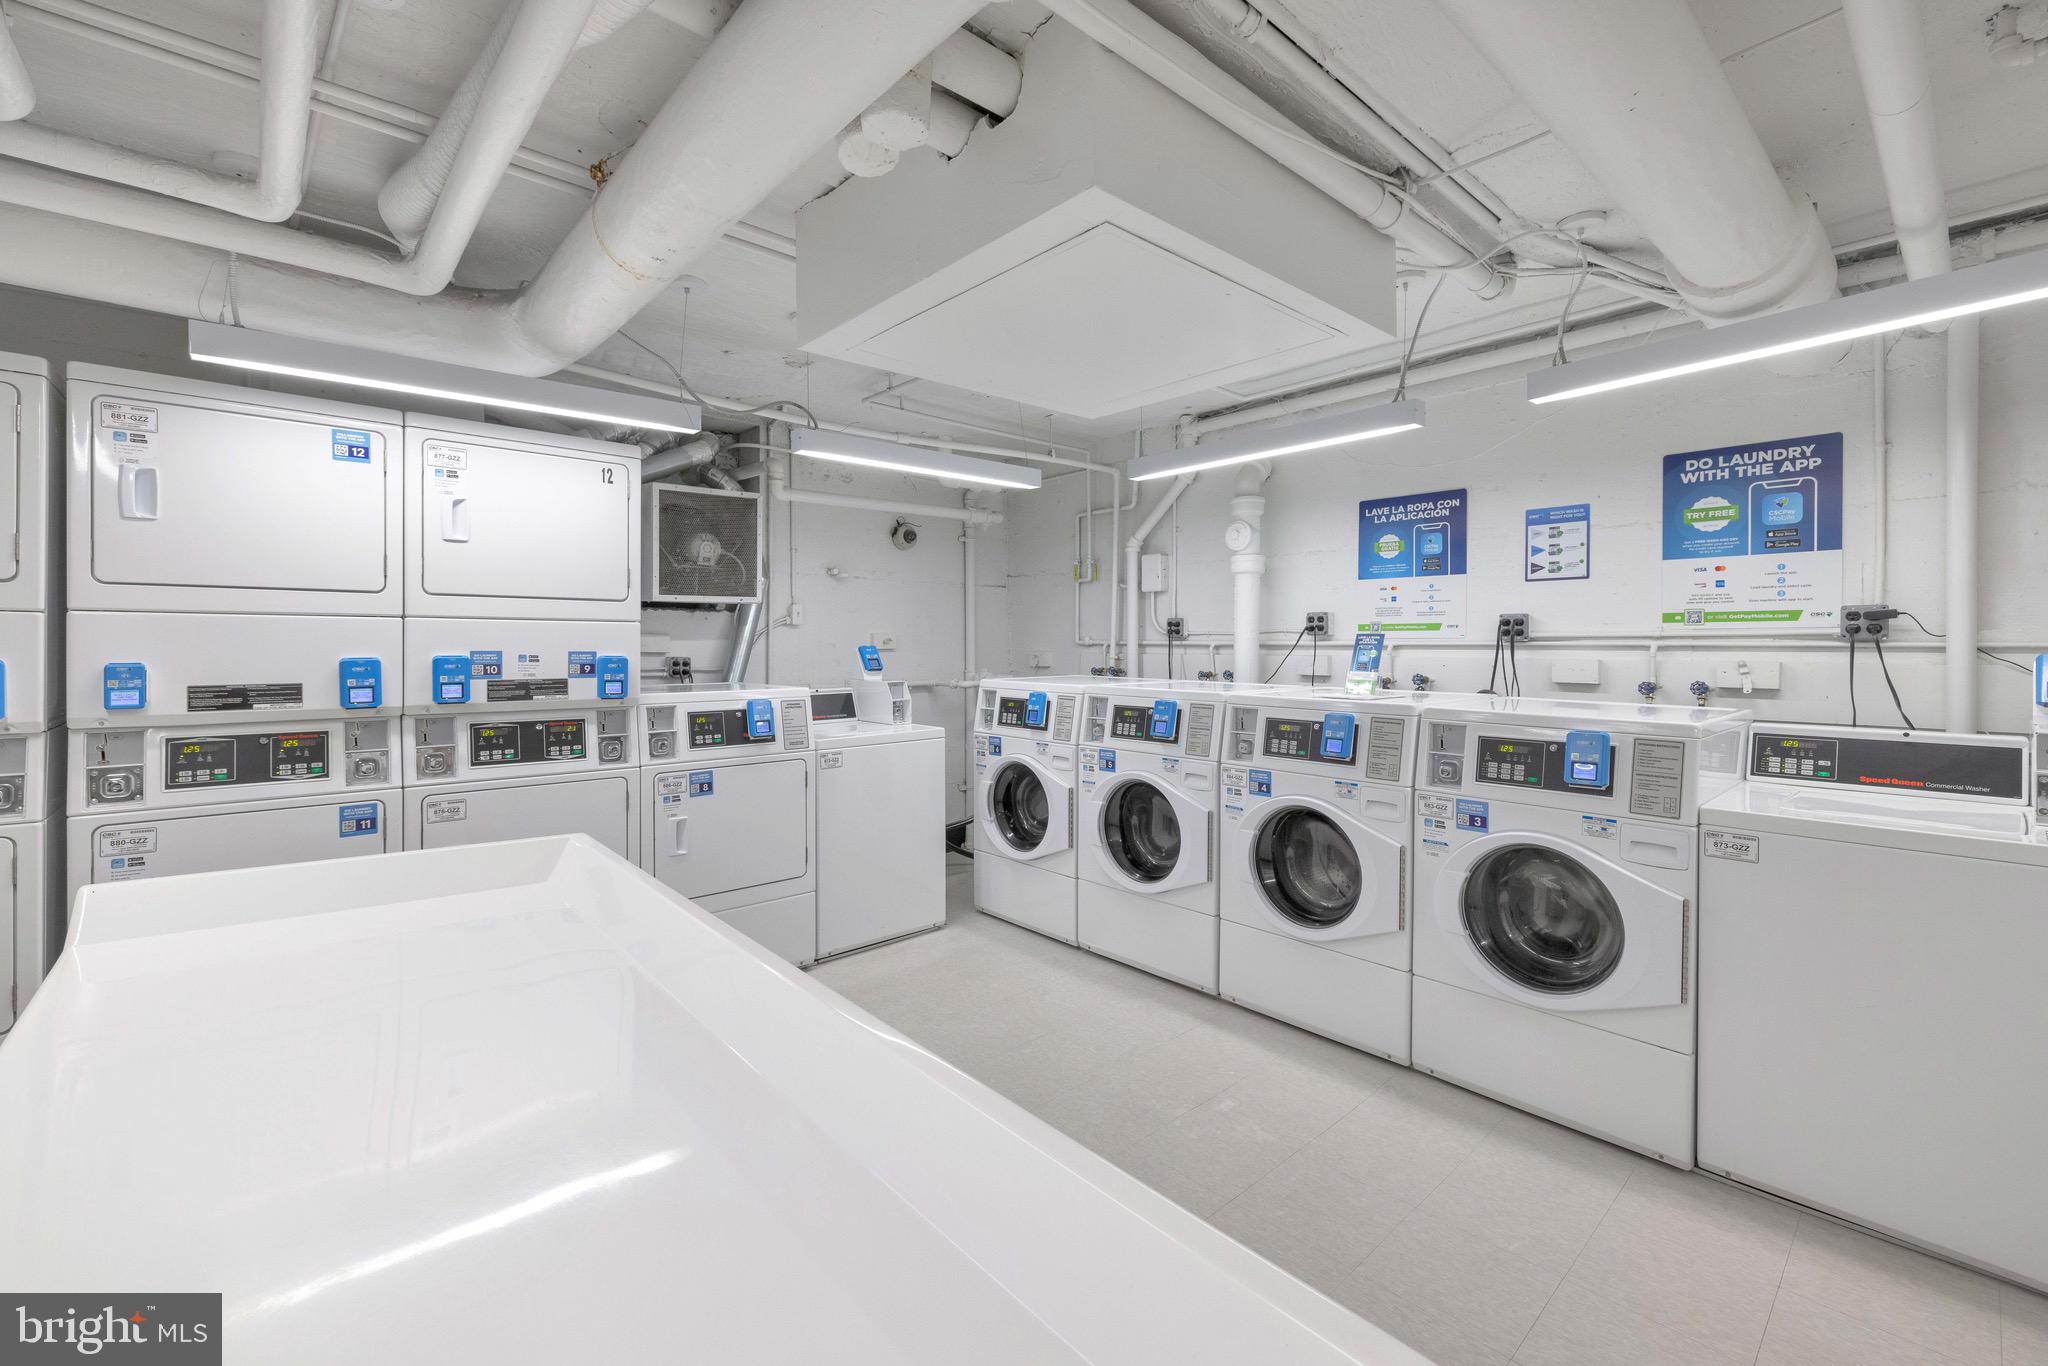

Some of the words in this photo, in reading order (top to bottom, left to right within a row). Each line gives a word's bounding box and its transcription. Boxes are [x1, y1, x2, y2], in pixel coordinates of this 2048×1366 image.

[110, 412, 149, 422] 881-GZZ
[352, 448, 366, 458] 12
[1686, 458, 1712, 471] DO
[1719, 444, 1816, 467] LAUNDRY
[602, 468, 614, 484] 12
[1680, 470, 1729, 484] WITH
[1735, 462, 1774, 478] THE
[1780, 458, 1822, 473] APP
[1366, 507, 1390, 517] LAVE
[1408, 502, 1434, 512] ROPA
[1437, 499, 1460, 509] CON
[1389, 507, 1449, 522] APLICACIÓN
[1686, 512, 1706, 520] TRY
[1708, 509, 1736, 518] FREE
[486, 666, 498, 674] 10
[1860, 775, 1890, 785] Speed
[1891, 778, 1924, 787] Queen
[1925, 782, 1964, 791] Commercial
[360, 820, 371, 828] 11
[1474, 817, 1481, 826] 3
[110, 838, 148, 846] 880-GZZ
[1714, 842, 1750, 851] 873-GZZ
